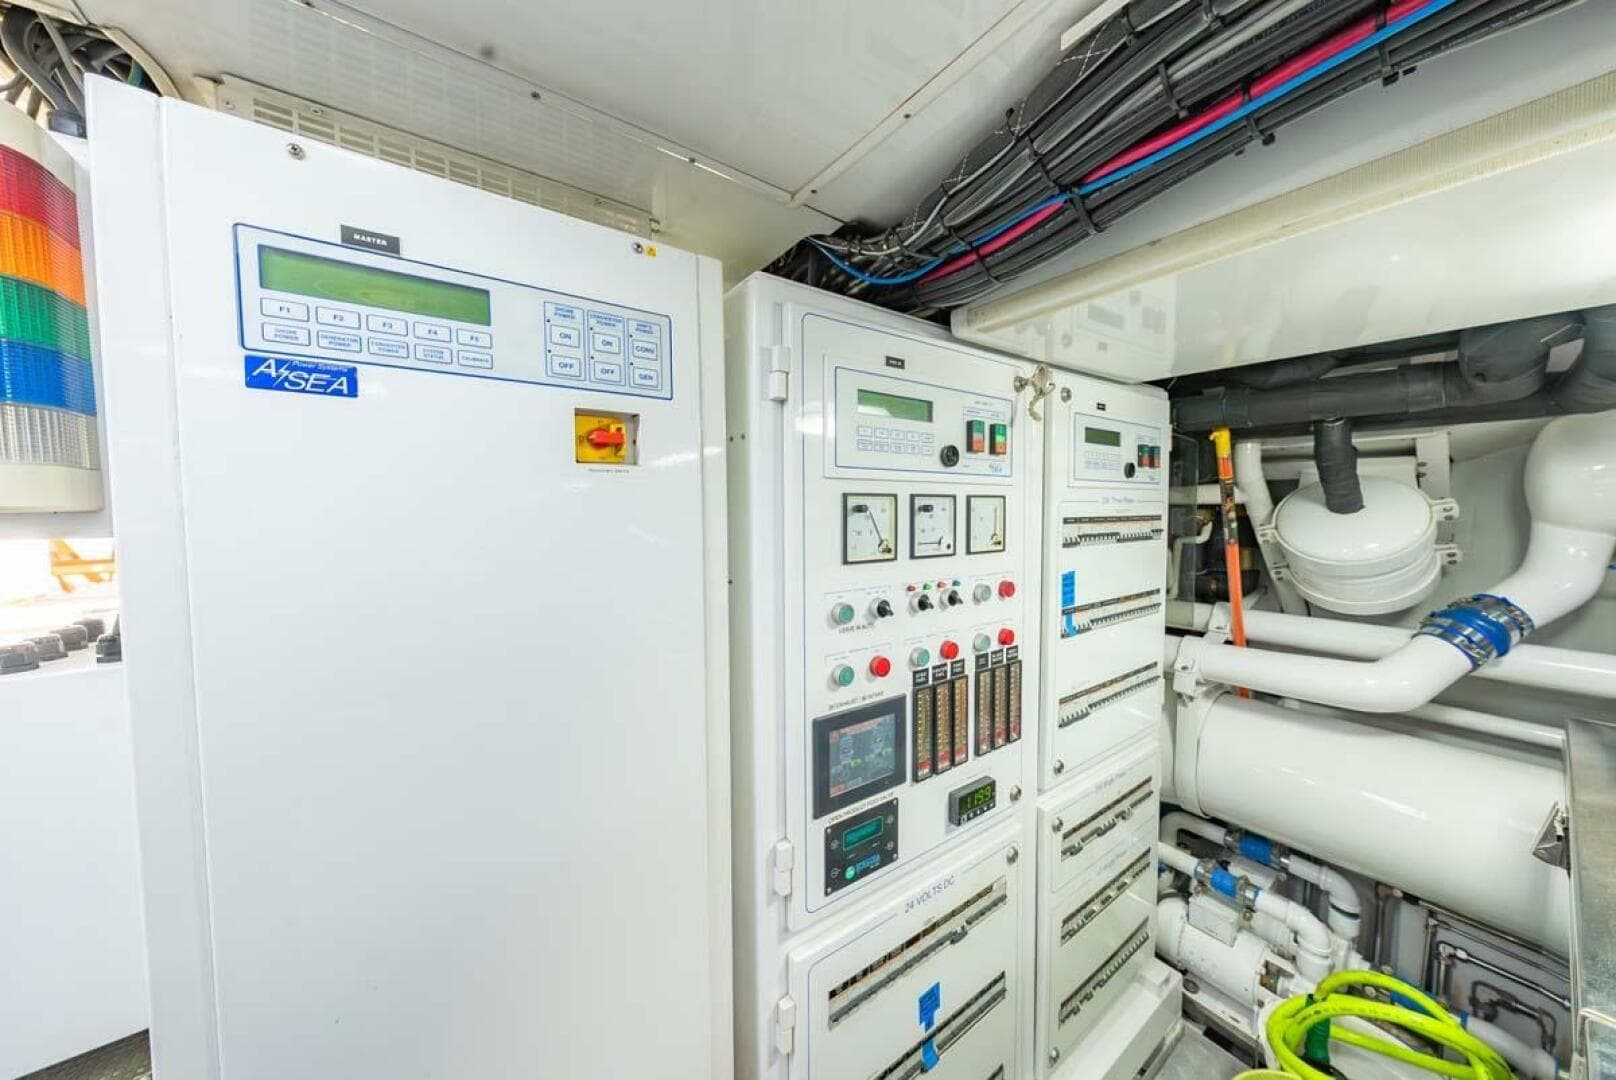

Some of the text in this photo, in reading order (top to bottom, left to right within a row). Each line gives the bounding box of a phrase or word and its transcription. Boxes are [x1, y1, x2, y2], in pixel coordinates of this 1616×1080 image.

[353, 232, 387, 246] MASTER
[279, 305, 291, 313] F1
[333, 314, 344, 322] F2
[382, 321, 393, 330] F3
[427, 328, 438, 336] F4
[559, 331, 572, 341] ON
[601, 339, 614, 348] ON
[558, 361, 575, 370] OFF
[600, 368, 615, 376] OFF
[637, 373, 655, 381] GEN
